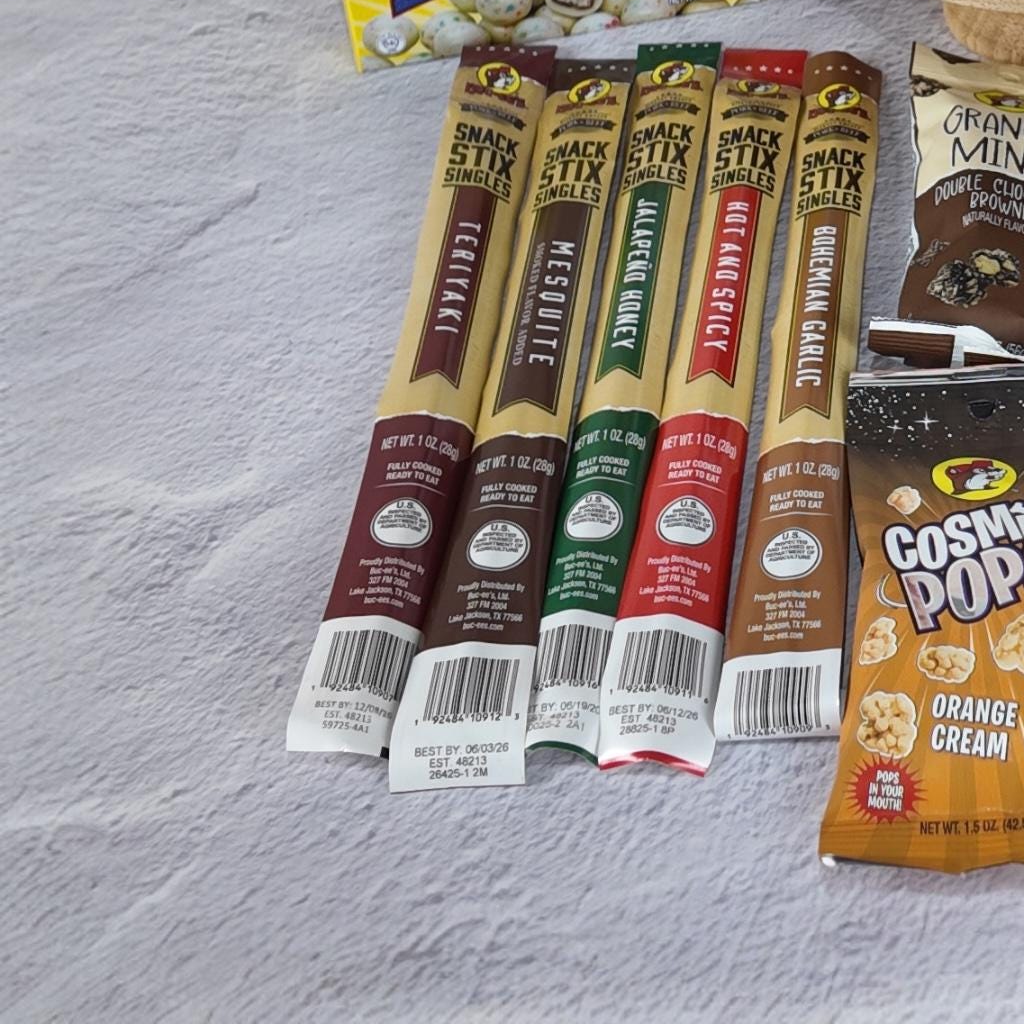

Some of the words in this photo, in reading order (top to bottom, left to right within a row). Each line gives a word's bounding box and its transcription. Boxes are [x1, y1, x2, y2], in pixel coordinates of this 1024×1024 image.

[454, 123, 519, 157] SNACK
[631, 122, 695, 149] SNACK
[718, 126, 783, 151] SNACK
[448, 142, 515, 182] STIX
[544, 141, 610, 165] SNACK
[627, 140, 691, 171] STIX
[714, 144, 780, 175] STIX
[802, 147, 866, 172] SNACK
[444, 167, 512, 198] SINGLES
[538, 159, 606, 189] STIX
[623, 164, 687, 189] SINGLES
[712, 168, 776, 192] SINGLES
[799, 166, 864, 196] STIX
[535, 184, 601, 205] SINGLES
[797, 190, 861, 213] SINGLES
[935, 174, 983, 206] DOUBLE
[725, 201, 750, 237] HOT
[963, 210, 1001, 227] NATURALLY
[623, 197, 658, 283] JALAPEÑO
[717, 242, 742, 280] AND
[803, 226, 836, 312] BOHEMIAN
[435, 221, 482, 333] TERIYAKI
[528, 240, 575, 367] MESQUITE
[610, 290, 642, 349] HONEY
[703, 288, 736, 352] SPICY
[512, 330, 527, 365] ADDED
[795, 320, 825, 388] GARLIC
[662, 435, 678, 450] NET
[680, 433, 694, 446] WT.
[697, 433, 701, 444] 1
[704, 435, 716, 448] OZ.
[718, 439, 736, 460] (28g)
[475, 458, 491, 474] NET
[493, 455, 507, 469] WT.
[511, 456, 515, 467] 1
[518, 456, 531, 469] OZ.
[533, 458, 555, 476] (28g)
[762, 467, 777, 484] NET
[779, 463, 793, 477] WT.
[796, 462, 799, 474] 1
[803, 462, 816, 475] OZ.
[818, 464, 840, 480] (28g)
[481, 483, 503, 493] FULLY
[505, 483, 537, 493] COOKED
[609, 705, 635, 715] BEST
[931, 693, 1020, 728] ORANGE
[415, 746, 442, 757] BEST
[466, 743, 509, 754] 06/03/26
[931, 724, 1009, 762] CREAM
[456, 755, 487, 766] 48213
[473, 768, 488, 776] 2M
[869, 782, 878, 795] IN
[880, 784, 903, 798] YOUR
[876, 770, 899, 784] POPS
[868, 796, 902, 811] MOUTH!
[920, 822, 939, 835] NET
[942, 822, 961, 835] WT.
[964, 822, 979, 834] 1.5
[983, 820, 999, 832] OZ.
